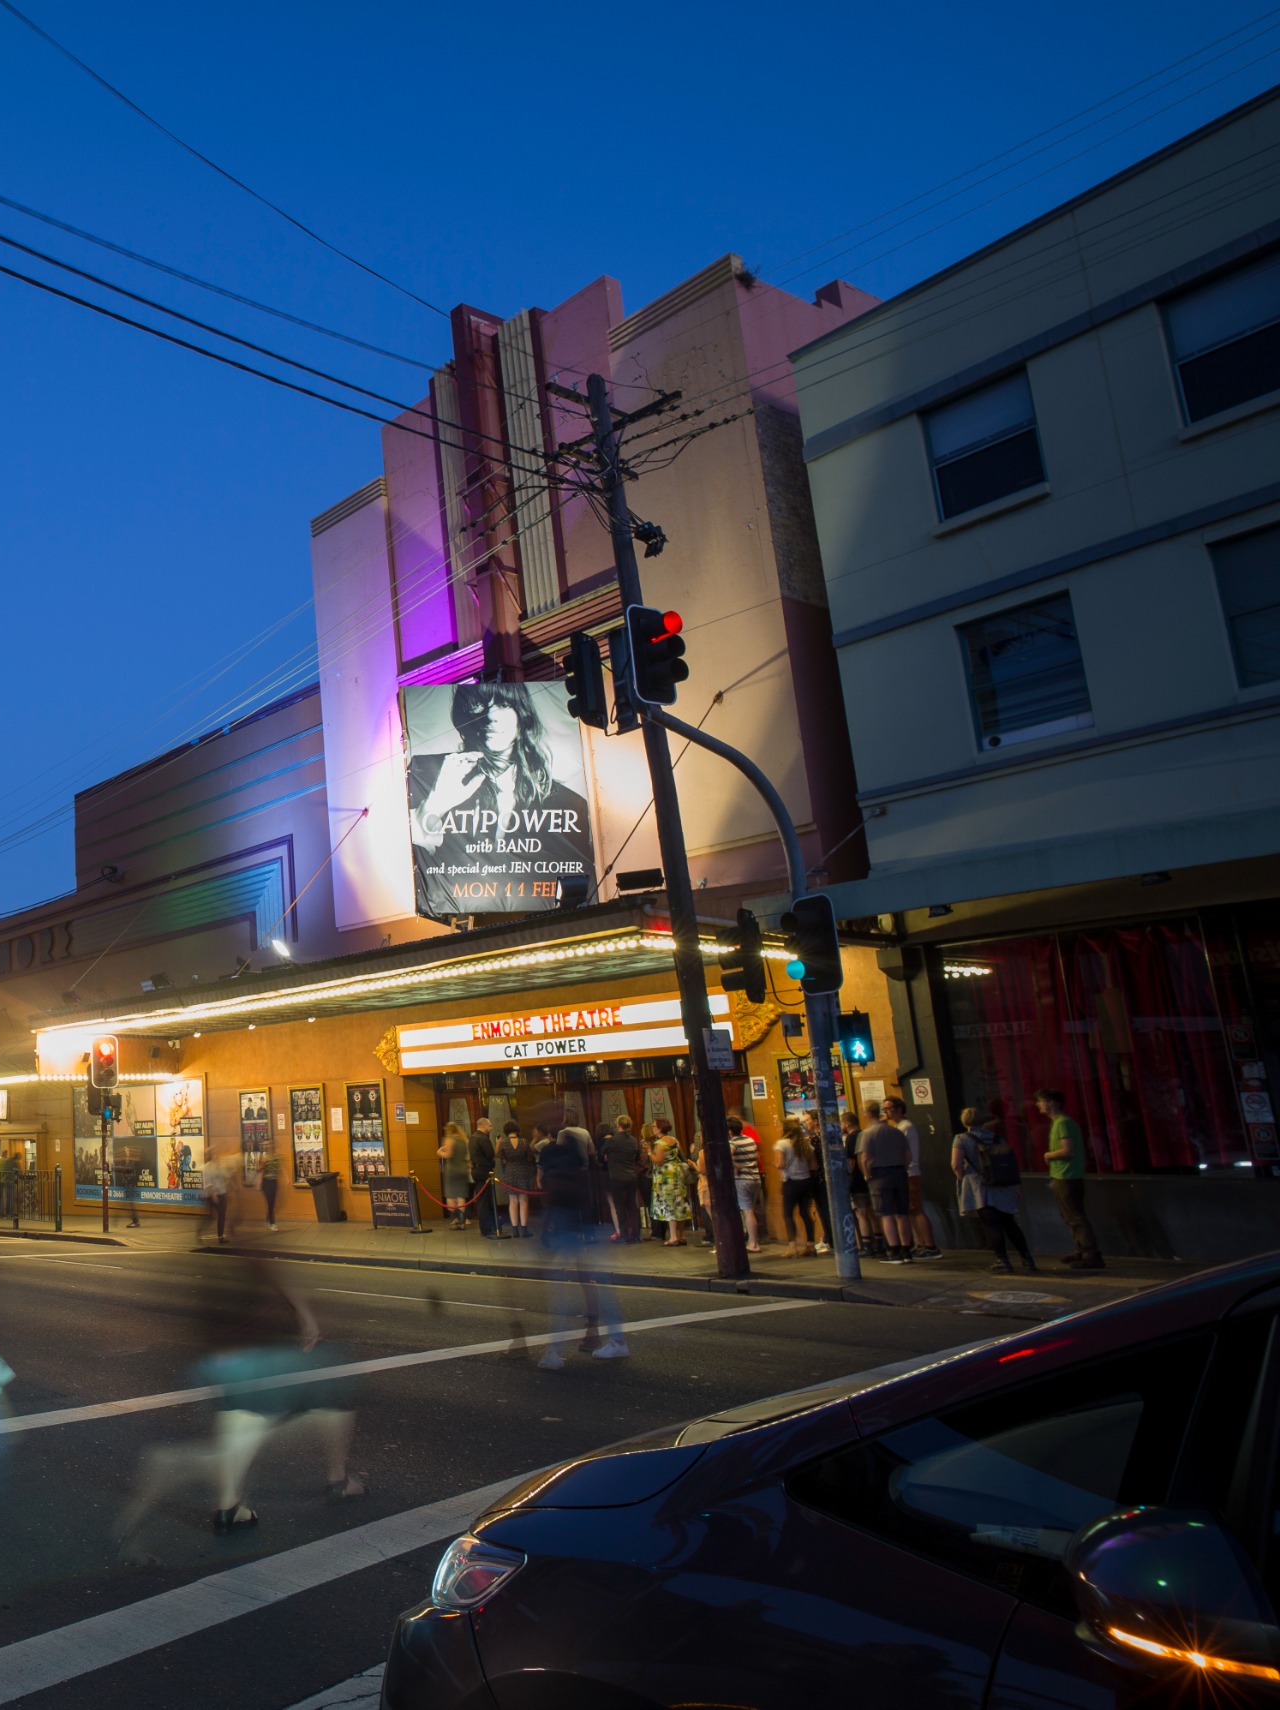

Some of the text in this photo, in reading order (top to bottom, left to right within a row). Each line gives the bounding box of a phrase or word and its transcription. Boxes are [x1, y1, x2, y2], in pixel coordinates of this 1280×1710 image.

[422, 809, 581, 834] CAT POWER
[465, 838, 542, 853] with BAND
[426, 861, 584, 876] and special guest JEN CLOHER
[452, 882, 498, 898] MON
[471, 1007, 622, 1041] ENMORE THEATRE
[504, 1038, 587, 1059] CAT POWER
[372, 1192, 409, 1203] ENMORE
